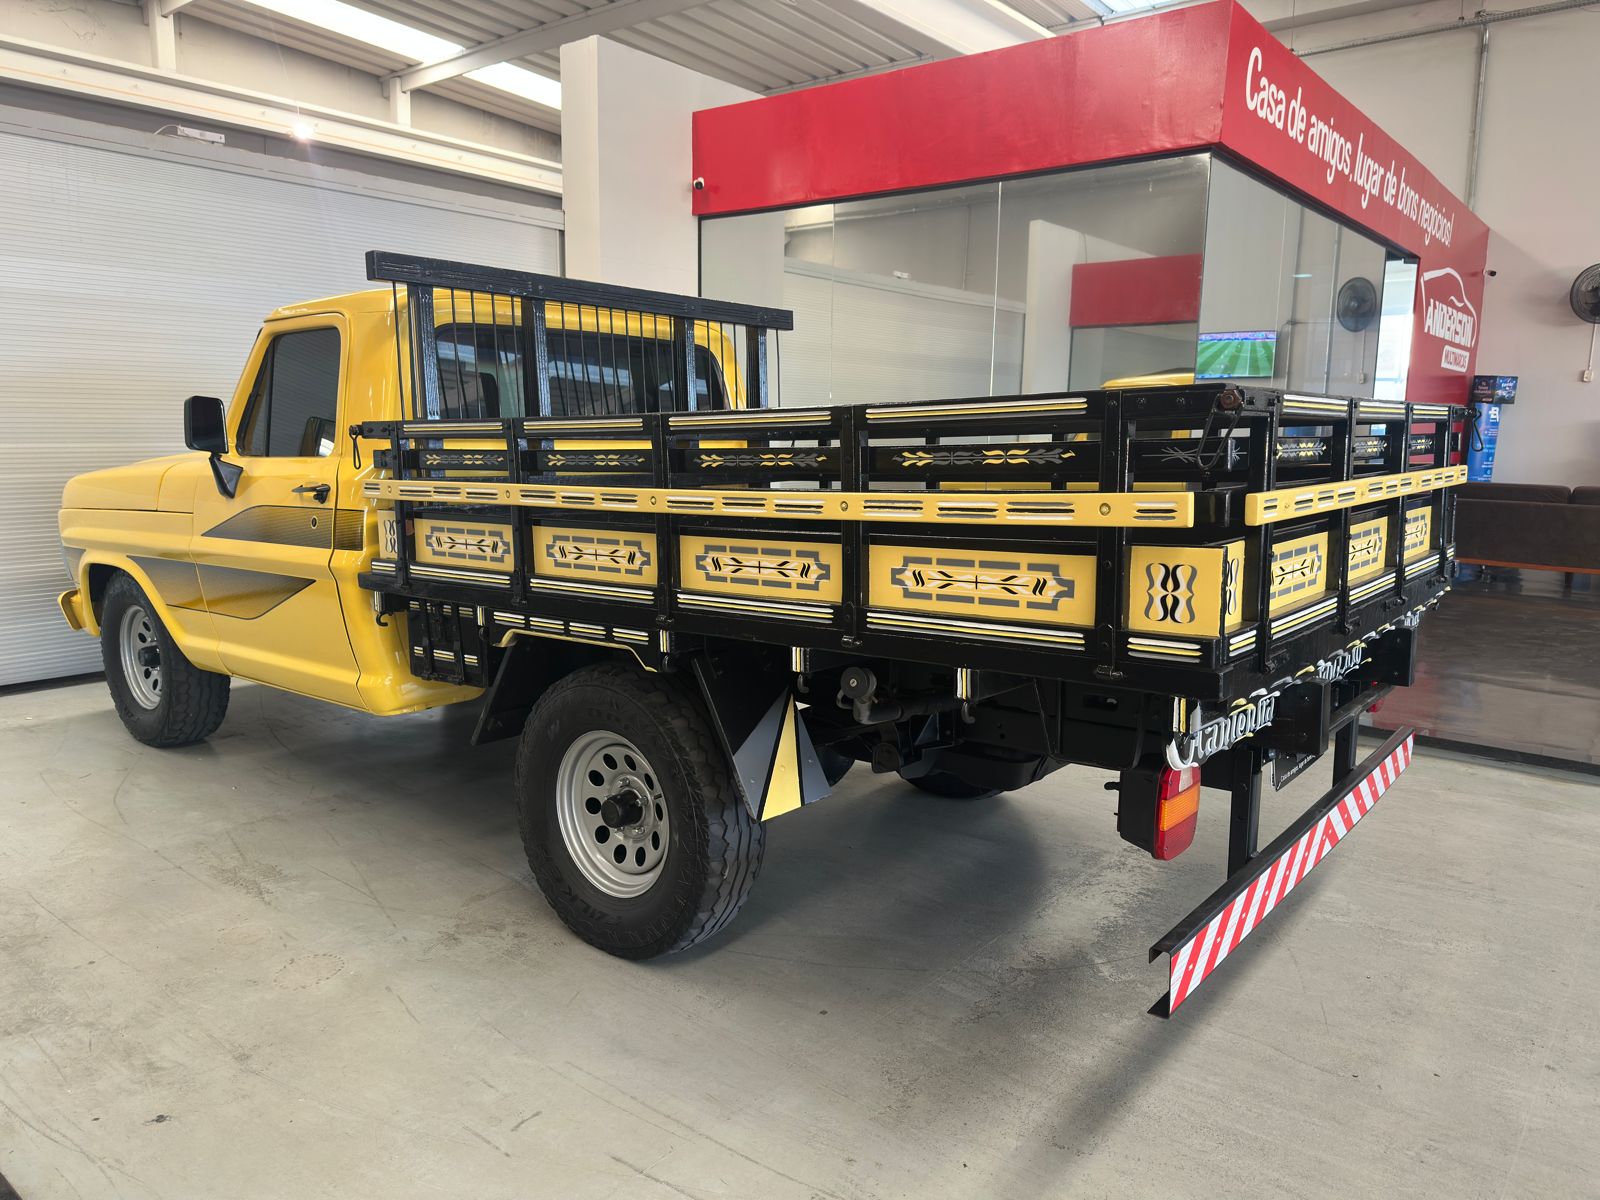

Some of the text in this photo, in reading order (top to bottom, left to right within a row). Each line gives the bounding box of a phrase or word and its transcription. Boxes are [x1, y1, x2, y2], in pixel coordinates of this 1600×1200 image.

[1246, 46, 1286, 131] Casa
[1287, 86, 1306, 144] de
[1308, 114, 1352, 184] amigos,
[1354, 132, 1384, 209] lugar
[1383, 160, 1397, 206] de
[1397, 167, 1419, 221] bons
[1424, 298, 1474, 347] ANDERSON
